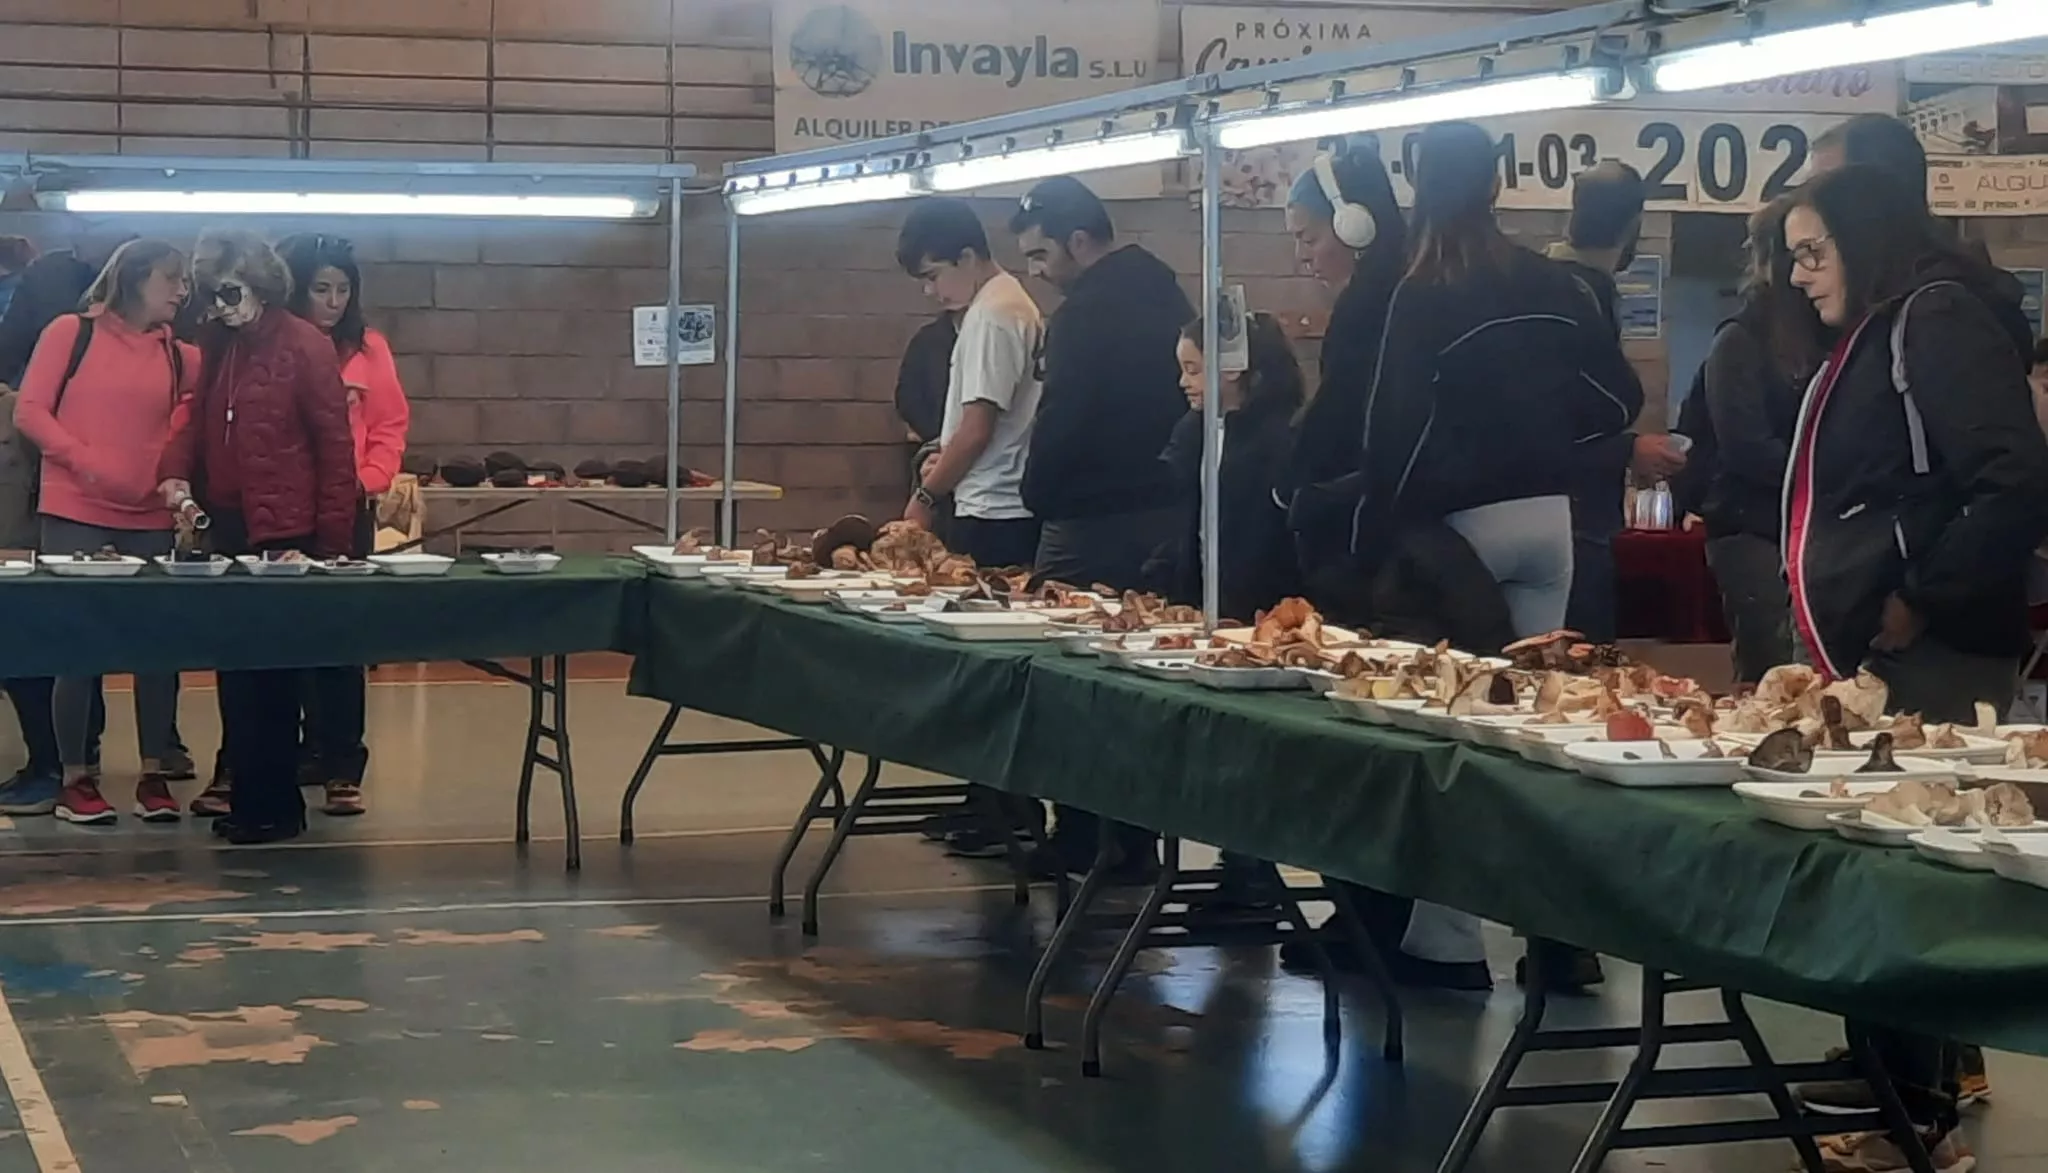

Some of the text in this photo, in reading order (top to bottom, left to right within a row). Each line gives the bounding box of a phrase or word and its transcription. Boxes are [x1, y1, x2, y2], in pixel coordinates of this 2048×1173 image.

[1235, 17, 1372, 40] PRÓXIMA
[892, 30, 1079, 88] Invayla
[793, 116, 913, 140] ALQUILER
[1636, 121, 1810, 203] 202
